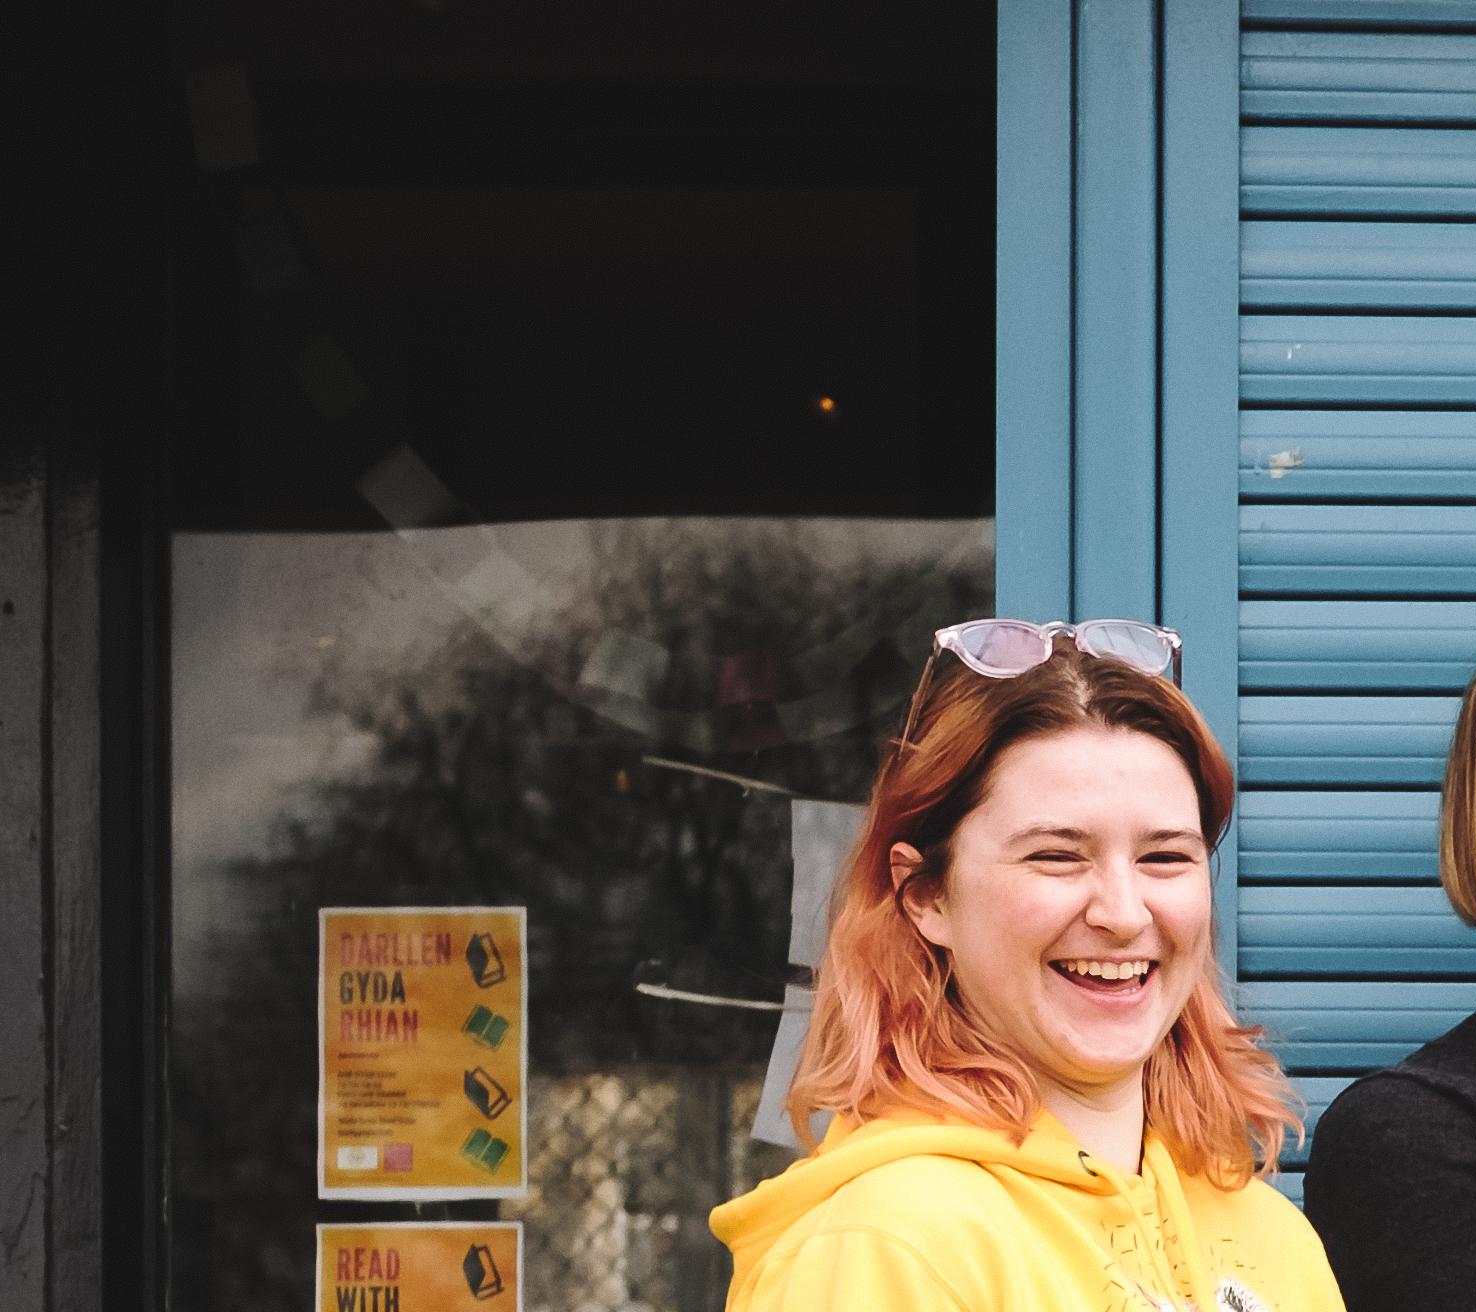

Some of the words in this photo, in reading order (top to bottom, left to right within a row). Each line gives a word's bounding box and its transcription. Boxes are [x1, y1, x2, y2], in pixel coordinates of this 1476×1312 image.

[341, 932, 451, 966] DARLLEN
[340, 970, 406, 1004] GYDA
[340, 1009, 418, 1043] RHIAN
[337, 1247, 400, 1281] READ
